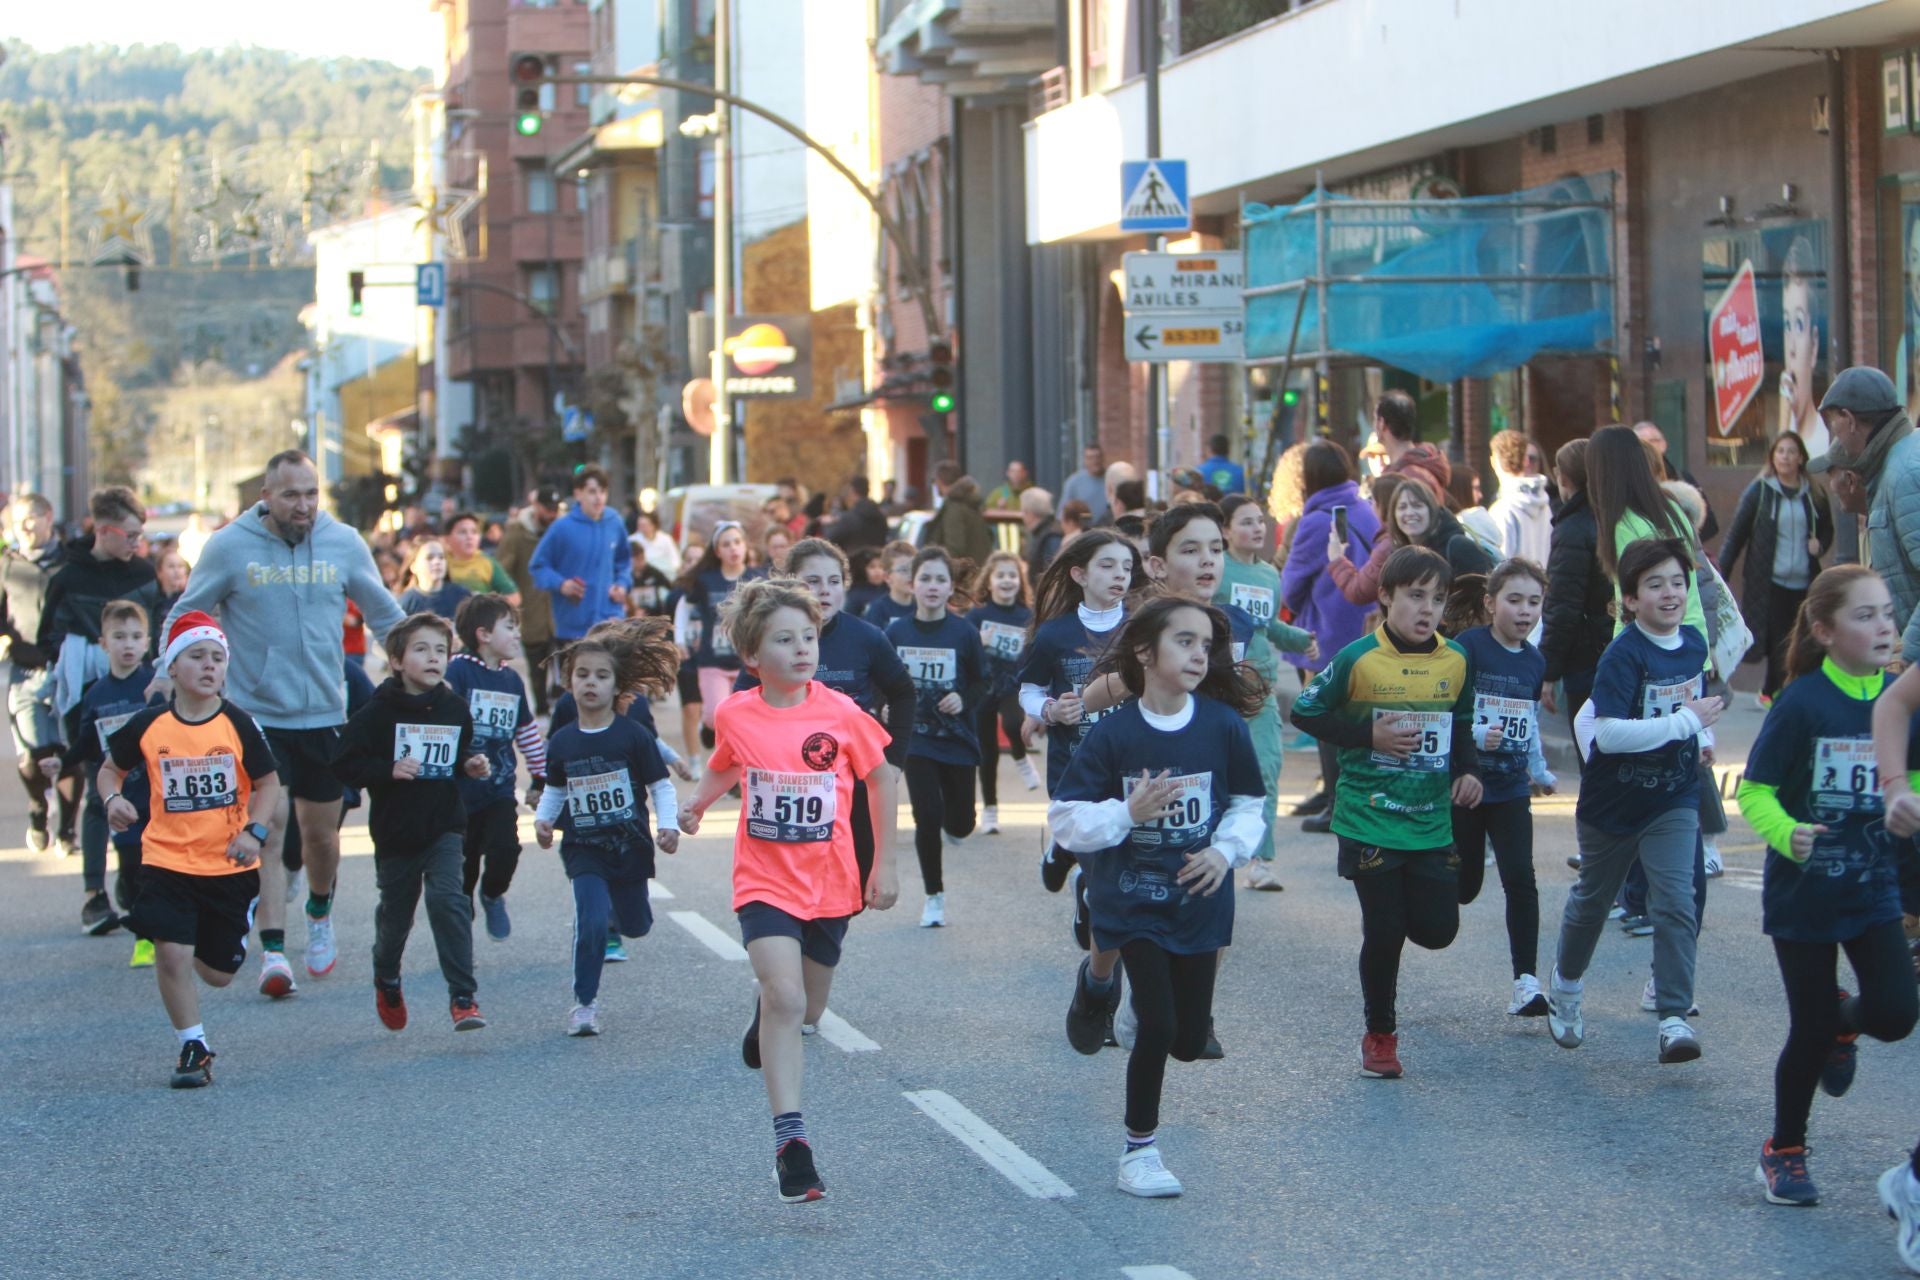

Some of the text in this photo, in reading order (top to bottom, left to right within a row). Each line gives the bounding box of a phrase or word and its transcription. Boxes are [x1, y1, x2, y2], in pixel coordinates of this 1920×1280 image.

[1131, 275, 1154, 288] LA
[1132, 292, 1199, 306] AVILES
[1246, 599, 1269, 617] 490
[996, 634, 1020, 652] 759
[919, 662, 944, 679] 717
[1486, 697, 1500, 706] SAN
[489, 707, 514, 728] 639
[1498, 715, 1528, 738] 756
[170, 757, 223, 767] SAN SILVESTRE
[422, 742, 450, 764] 770
[185, 772, 227, 798] 633
[758, 771, 823, 786] SAN SILVESTRE
[772, 785, 809, 794] LLANERA
[586, 788, 625, 814] 686
[774, 795, 823, 824] 519
